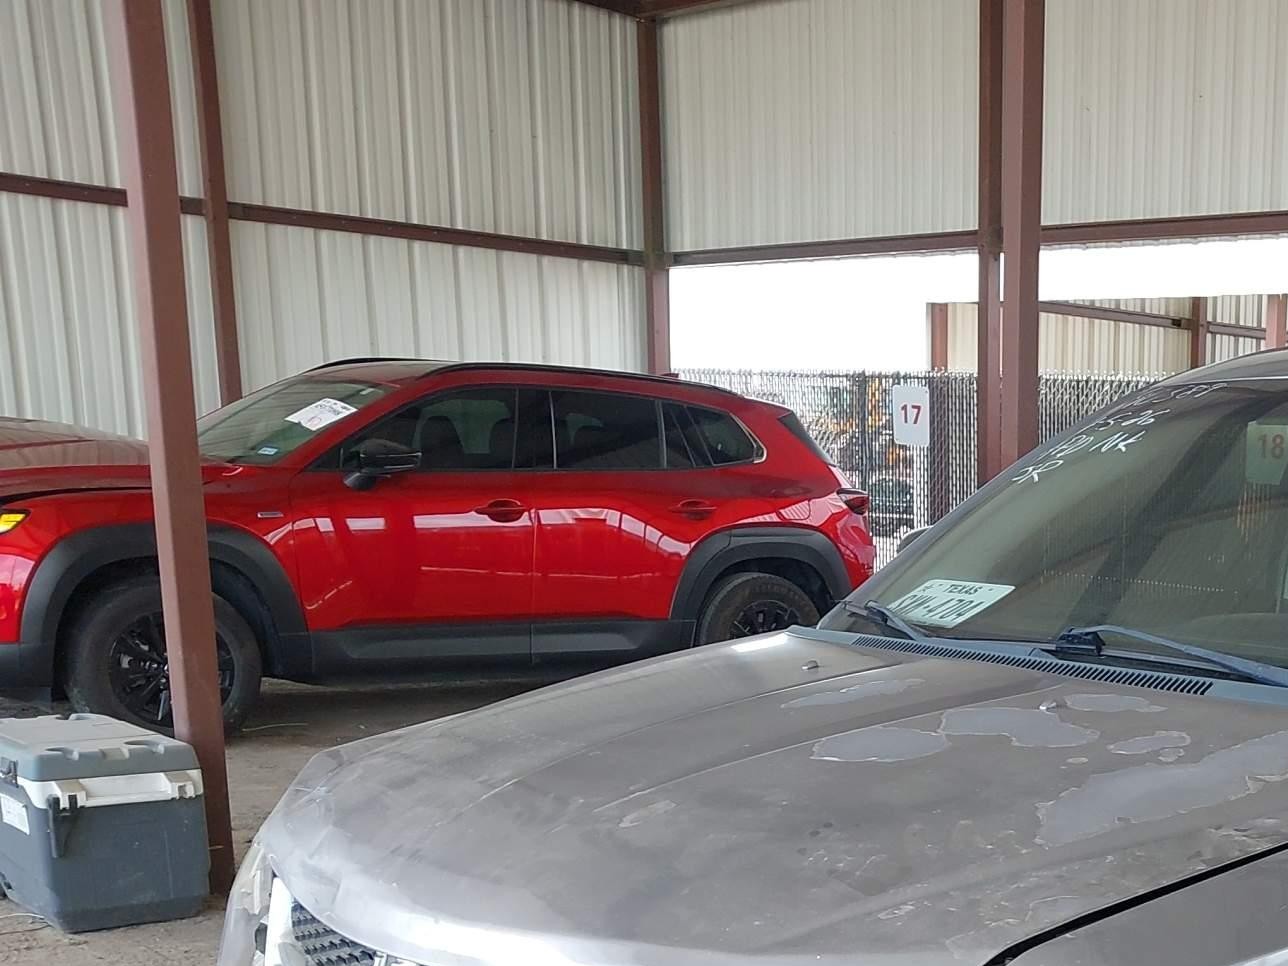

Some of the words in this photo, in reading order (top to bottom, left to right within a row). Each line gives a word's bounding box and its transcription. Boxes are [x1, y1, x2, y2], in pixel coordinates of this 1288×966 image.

[900, 404, 921, 425] 17
[1258, 433, 1285, 459] 18
[943, 584, 983, 595] TEXAS
